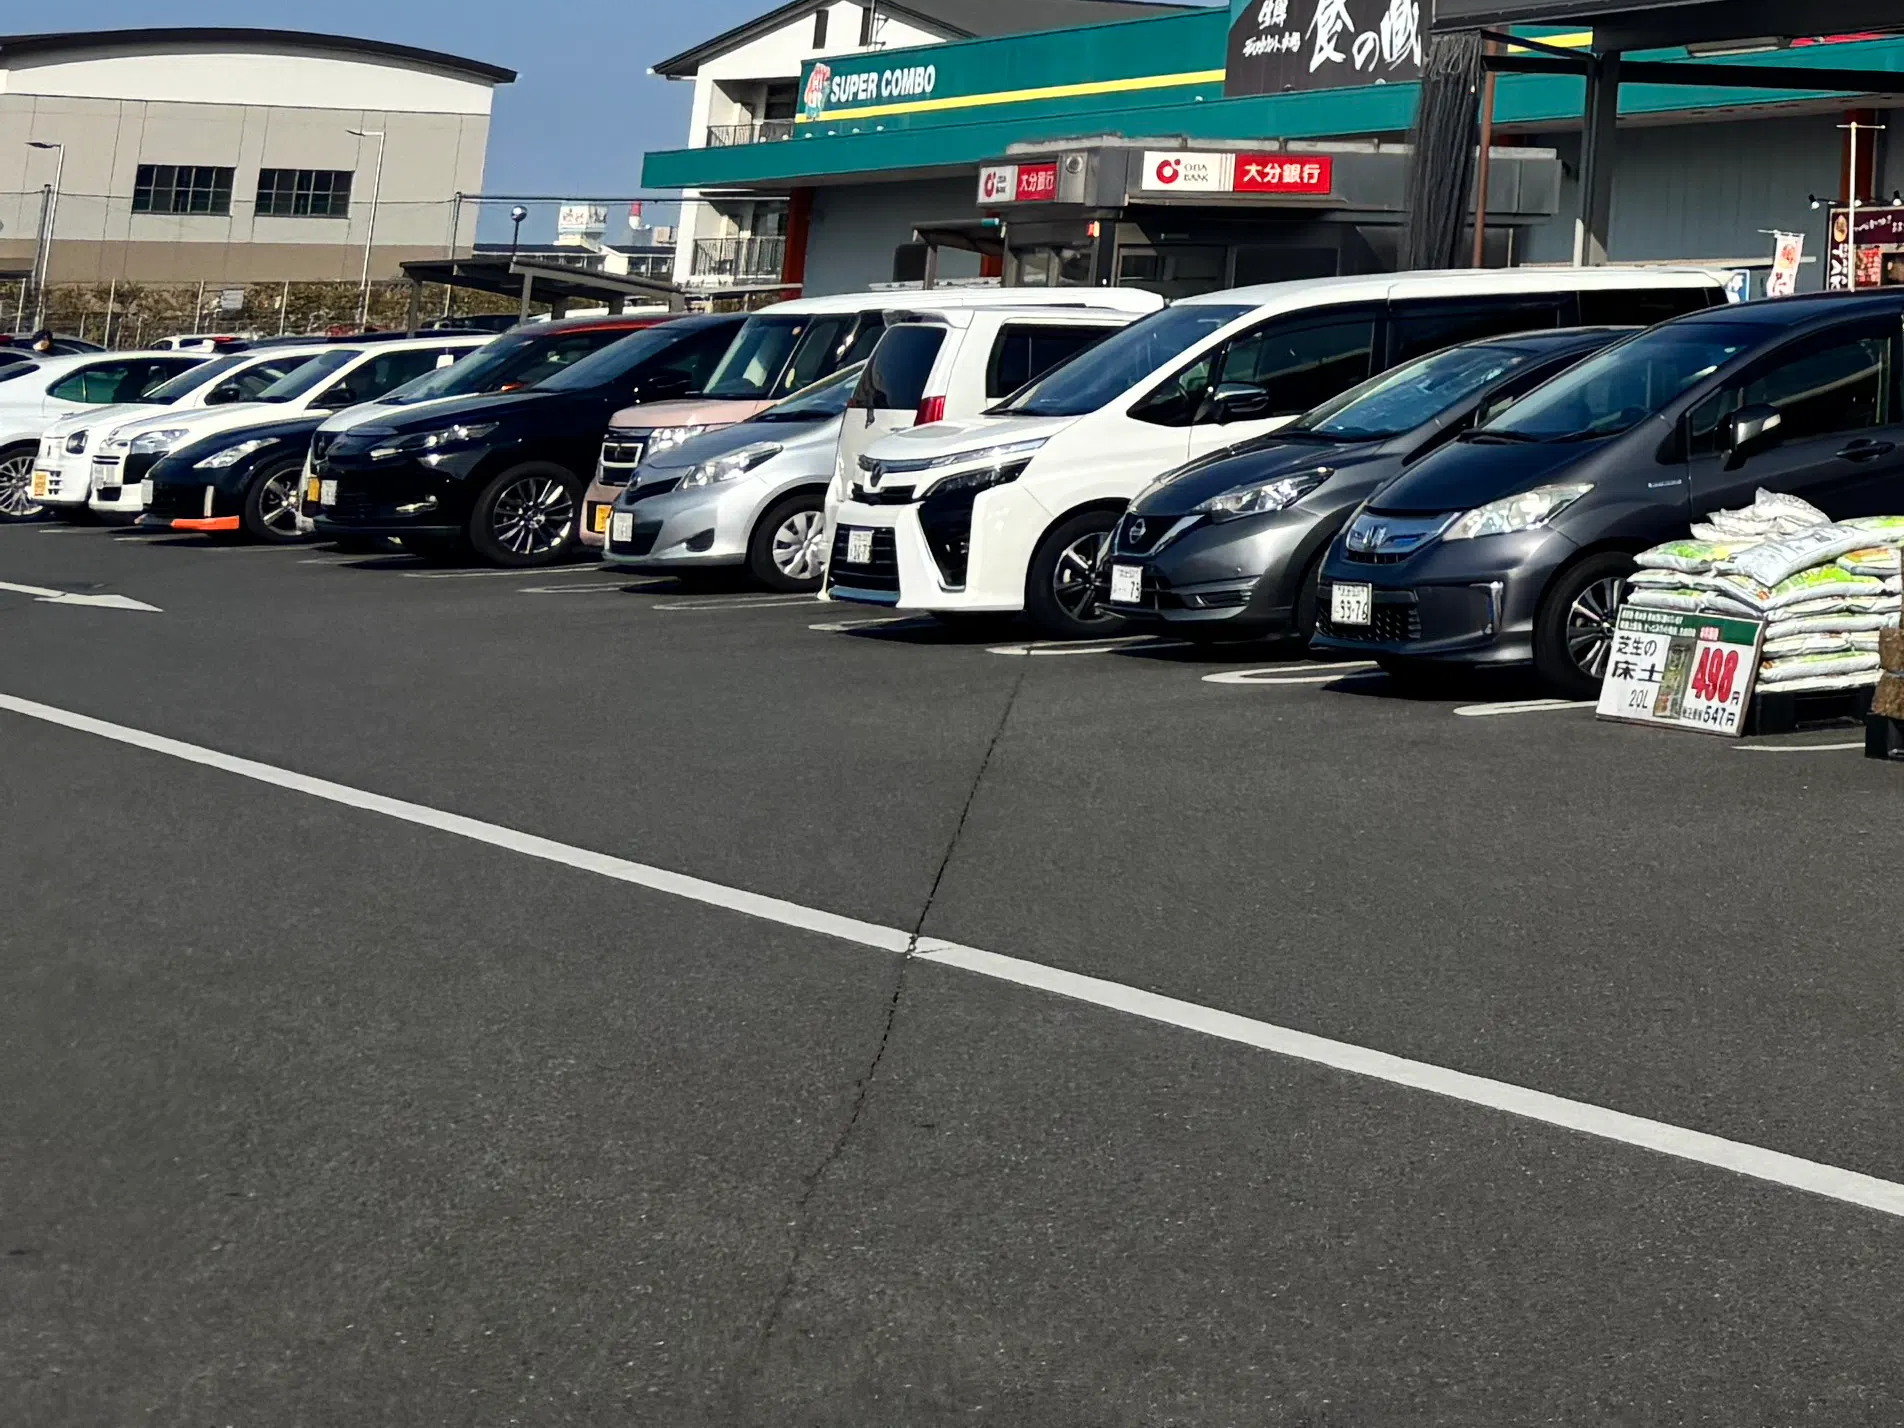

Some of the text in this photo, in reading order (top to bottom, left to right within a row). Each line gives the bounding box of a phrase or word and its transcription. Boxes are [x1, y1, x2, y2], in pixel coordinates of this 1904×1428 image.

[830, 72, 879, 102] SUPER
[881, 64, 936, 97] COMBO
[1243, 163, 1320, 183] 大分銀行
[1616, 635, 1658, 657] 芝生の
[1611, 660, 1664, 684] 床土
[1691, 646, 1739, 703] 498
[1628, 689, 1648, 709] 20L
